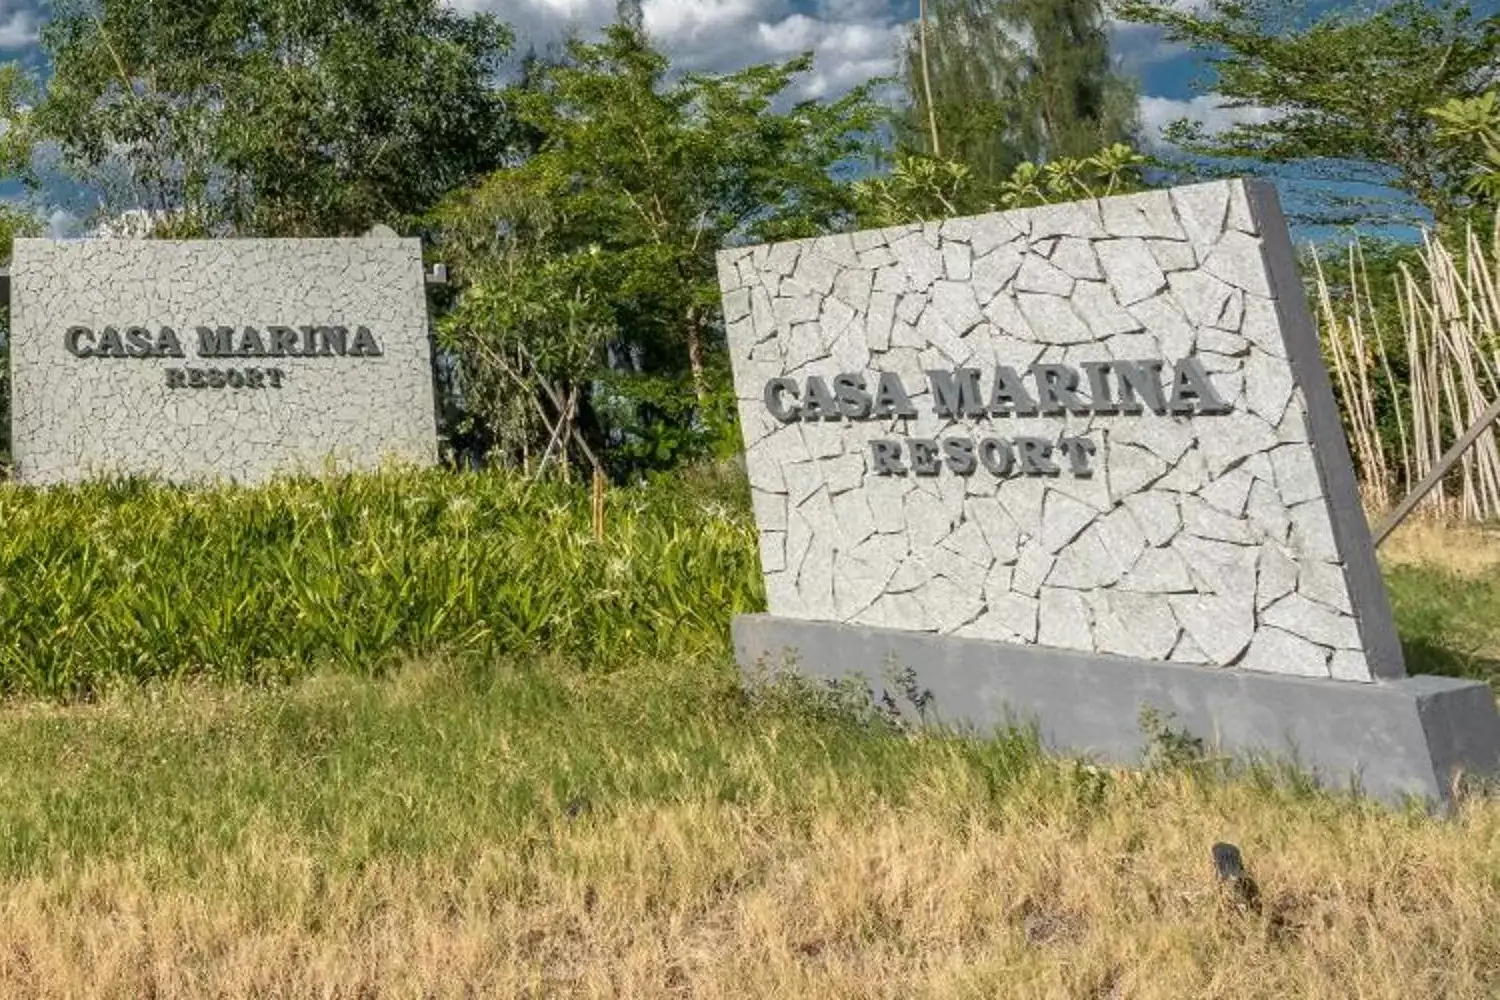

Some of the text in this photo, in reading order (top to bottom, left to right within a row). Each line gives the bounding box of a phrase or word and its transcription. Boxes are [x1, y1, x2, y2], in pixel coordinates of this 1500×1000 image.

[64, 325, 382, 358] CASA MARINA
[165, 367, 286, 390] RESORT
[763, 357, 1234, 423] CASA MARINA
[867, 436, 1097, 480] RESORT
